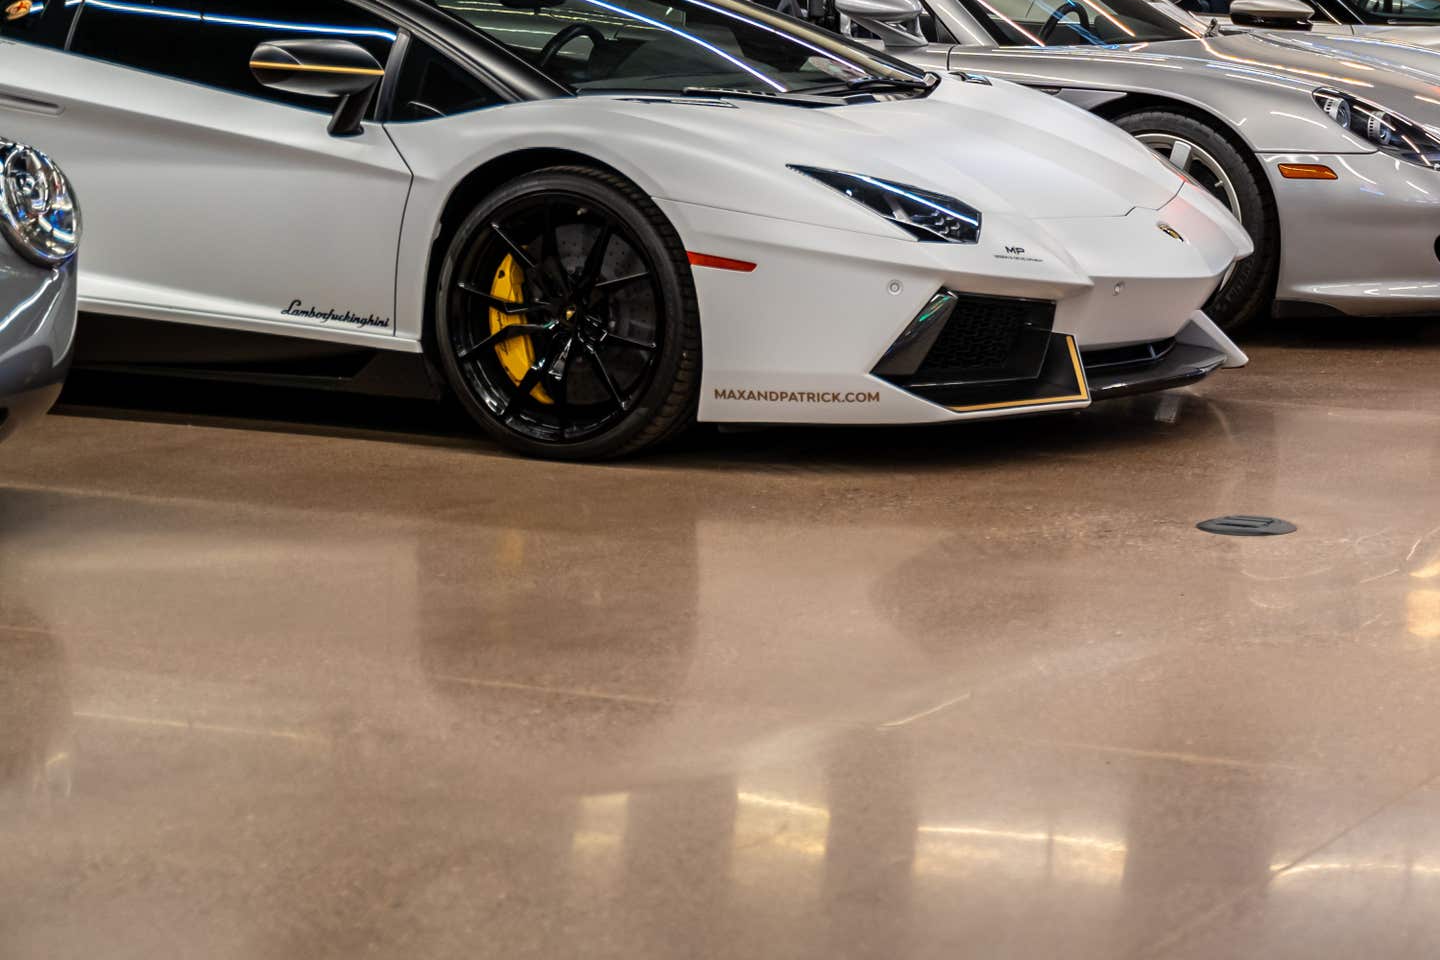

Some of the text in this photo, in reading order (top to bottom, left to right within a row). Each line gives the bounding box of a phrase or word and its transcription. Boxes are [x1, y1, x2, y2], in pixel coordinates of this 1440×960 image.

[1004, 246, 1025, 255] MP
[280, 299, 390, 329] Lamborfuckinghini
[713, 388, 880, 403] MAXANDPATRICK.COM
